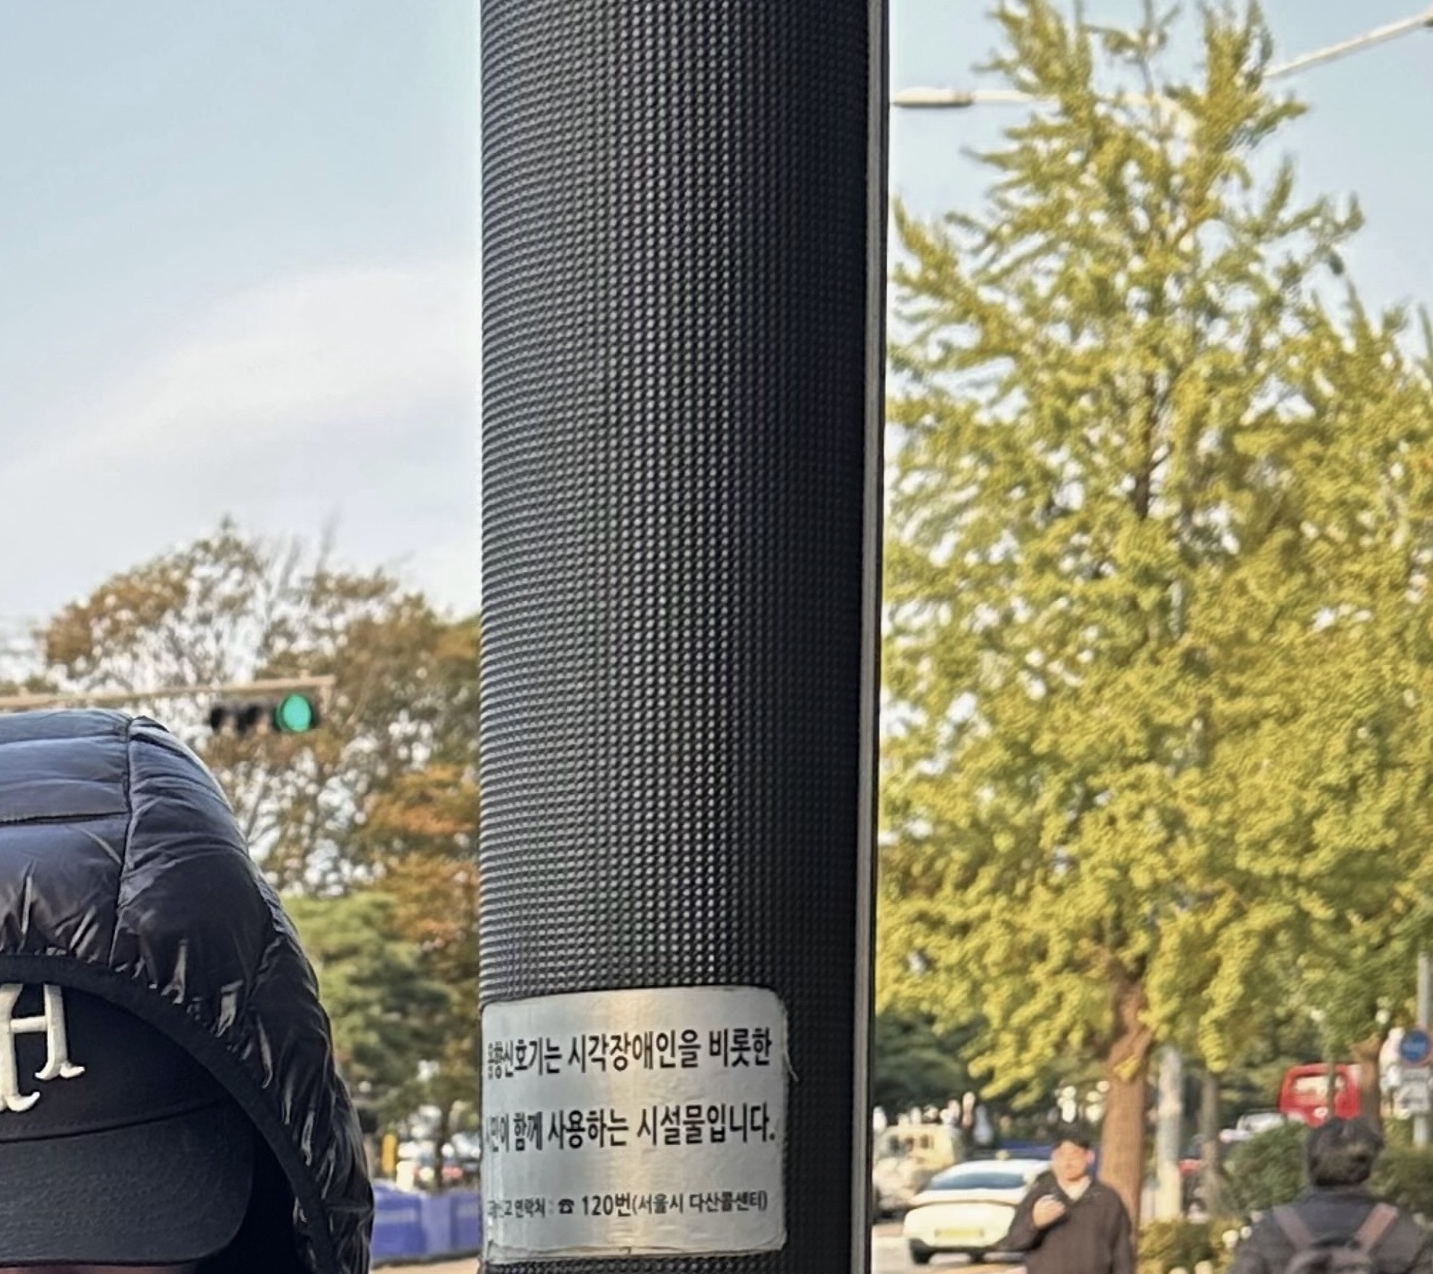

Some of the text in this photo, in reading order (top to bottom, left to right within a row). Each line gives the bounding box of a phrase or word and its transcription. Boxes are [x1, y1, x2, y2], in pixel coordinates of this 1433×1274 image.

[568, 1029, 702, 1074] 시각장애인을
[709, 1027, 772, 1068] 비롯한
[513, 1111, 543, 1151] 함께
[547, 1109, 629, 1150] 사용하는
[637, 1102, 777, 1146] 시설물입니다.
